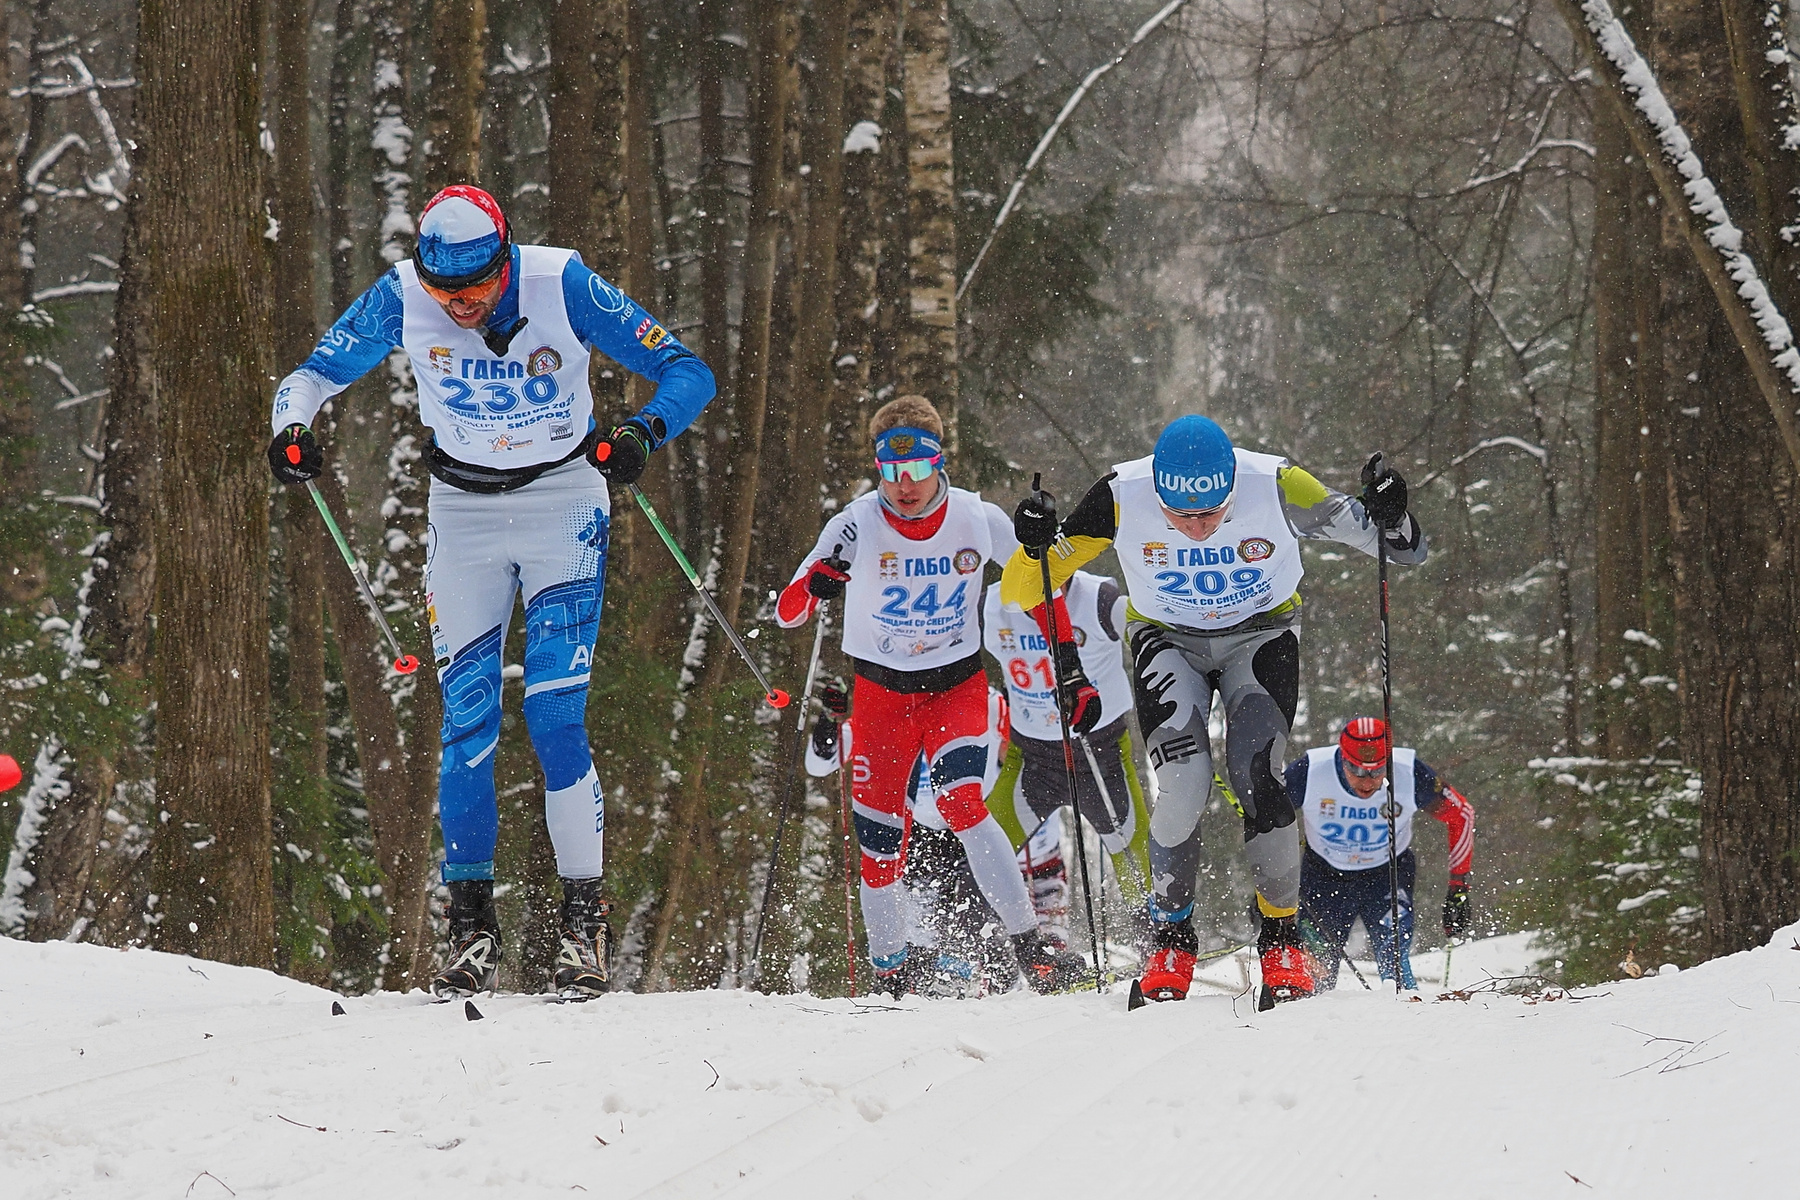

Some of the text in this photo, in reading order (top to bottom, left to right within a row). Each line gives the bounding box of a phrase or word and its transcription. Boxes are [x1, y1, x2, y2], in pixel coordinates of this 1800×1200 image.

[439, 373, 560, 414] 230
[1158, 470, 1228, 494] LUKOIL
[904, 556, 951, 578] ГАБО
[1176, 546, 1236, 567] ГАБО
[1154, 566, 1264, 597] 209
[880, 579, 969, 618] 244
[1340, 805, 1378, 820] ГАБО
[1320, 821, 1389, 844] 207
